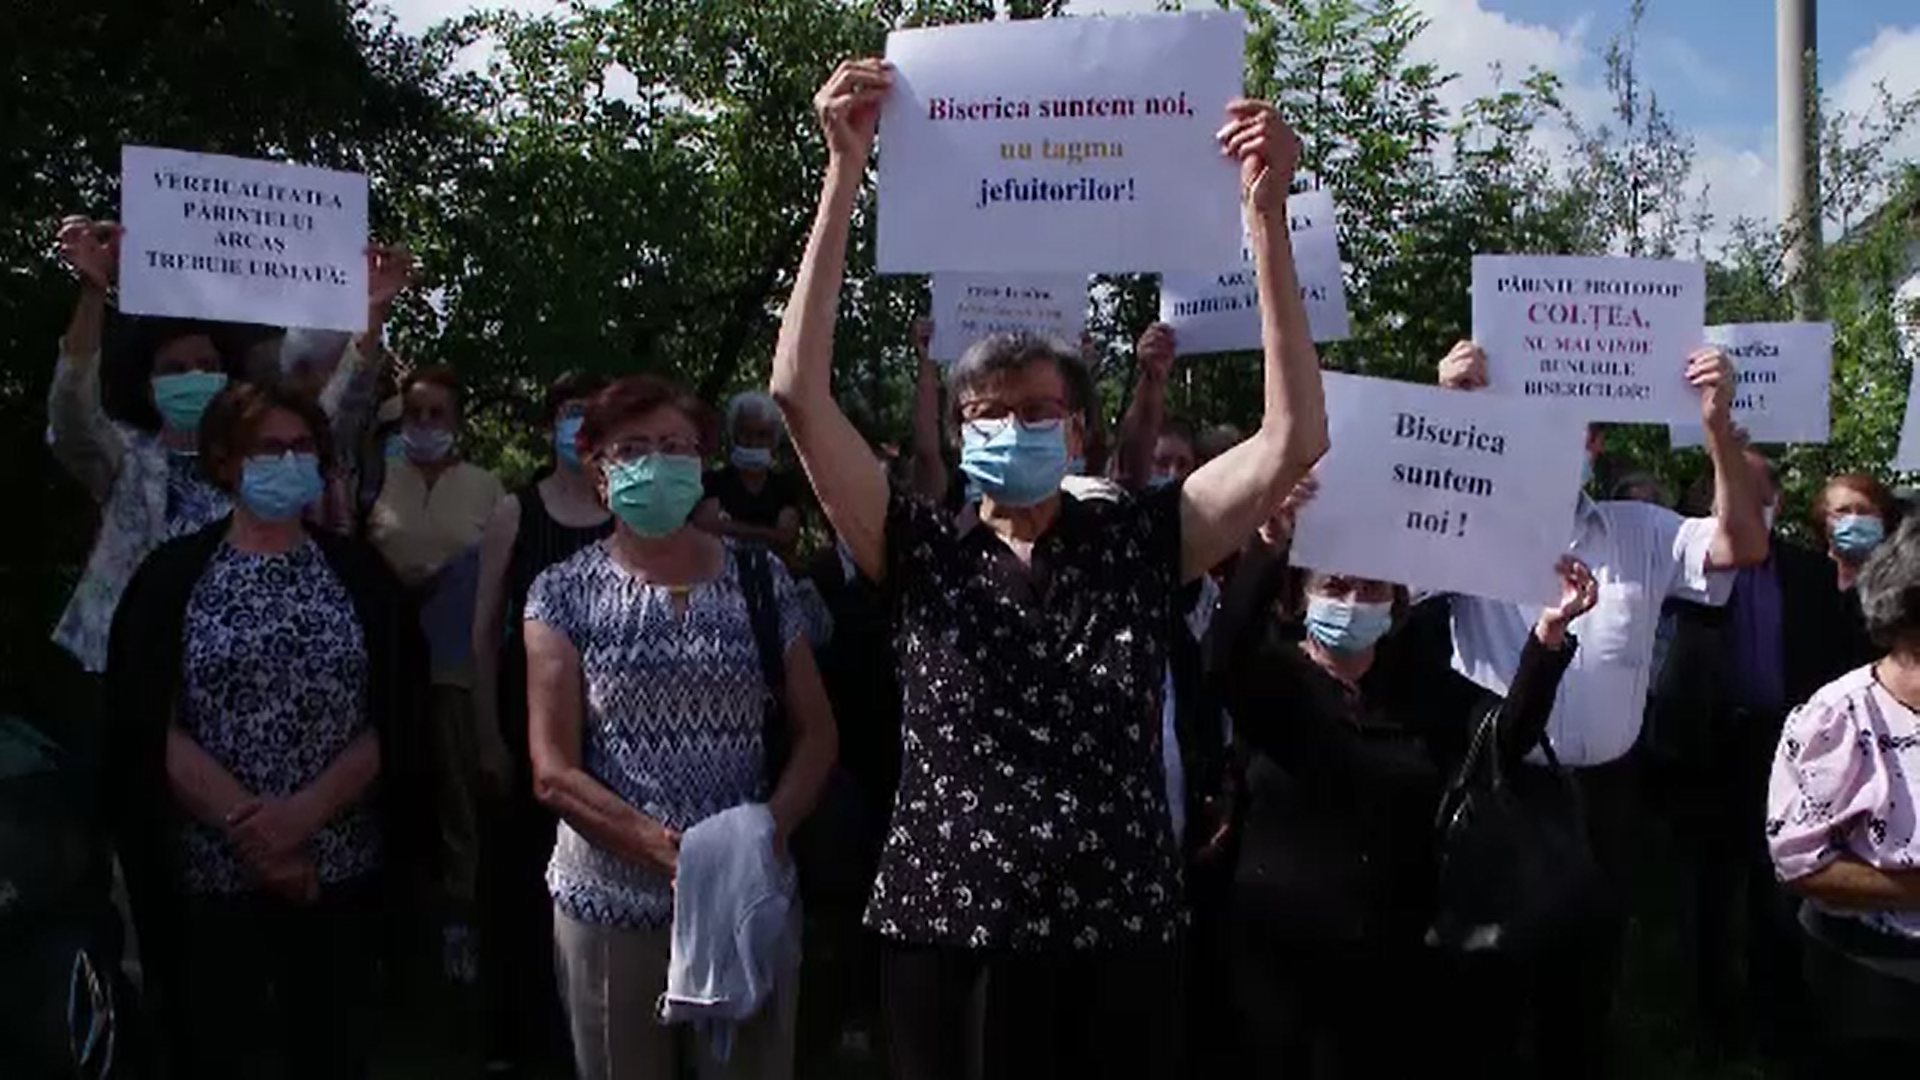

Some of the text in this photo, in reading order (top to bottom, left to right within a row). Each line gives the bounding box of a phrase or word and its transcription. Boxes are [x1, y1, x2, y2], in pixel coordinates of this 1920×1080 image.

[929, 91, 1194, 121] Biserica suntem noi,
[1042, 138, 1124, 165] tagma
[154, 171, 343, 209] VERTICALITATEA
[976, 177, 1136, 208] jefuitorilor!
[146, 250, 243, 276] TREBUIE
[1523, 335, 1653, 355] NU MAI VINDE
[1728, 341, 1779, 357] serica
[1539, 358, 1636, 376] BUNURILE
[1394, 411, 1506, 455] Biserica
[1392, 462, 1494, 497] suntem
[1405, 509, 1468, 537] noi !
